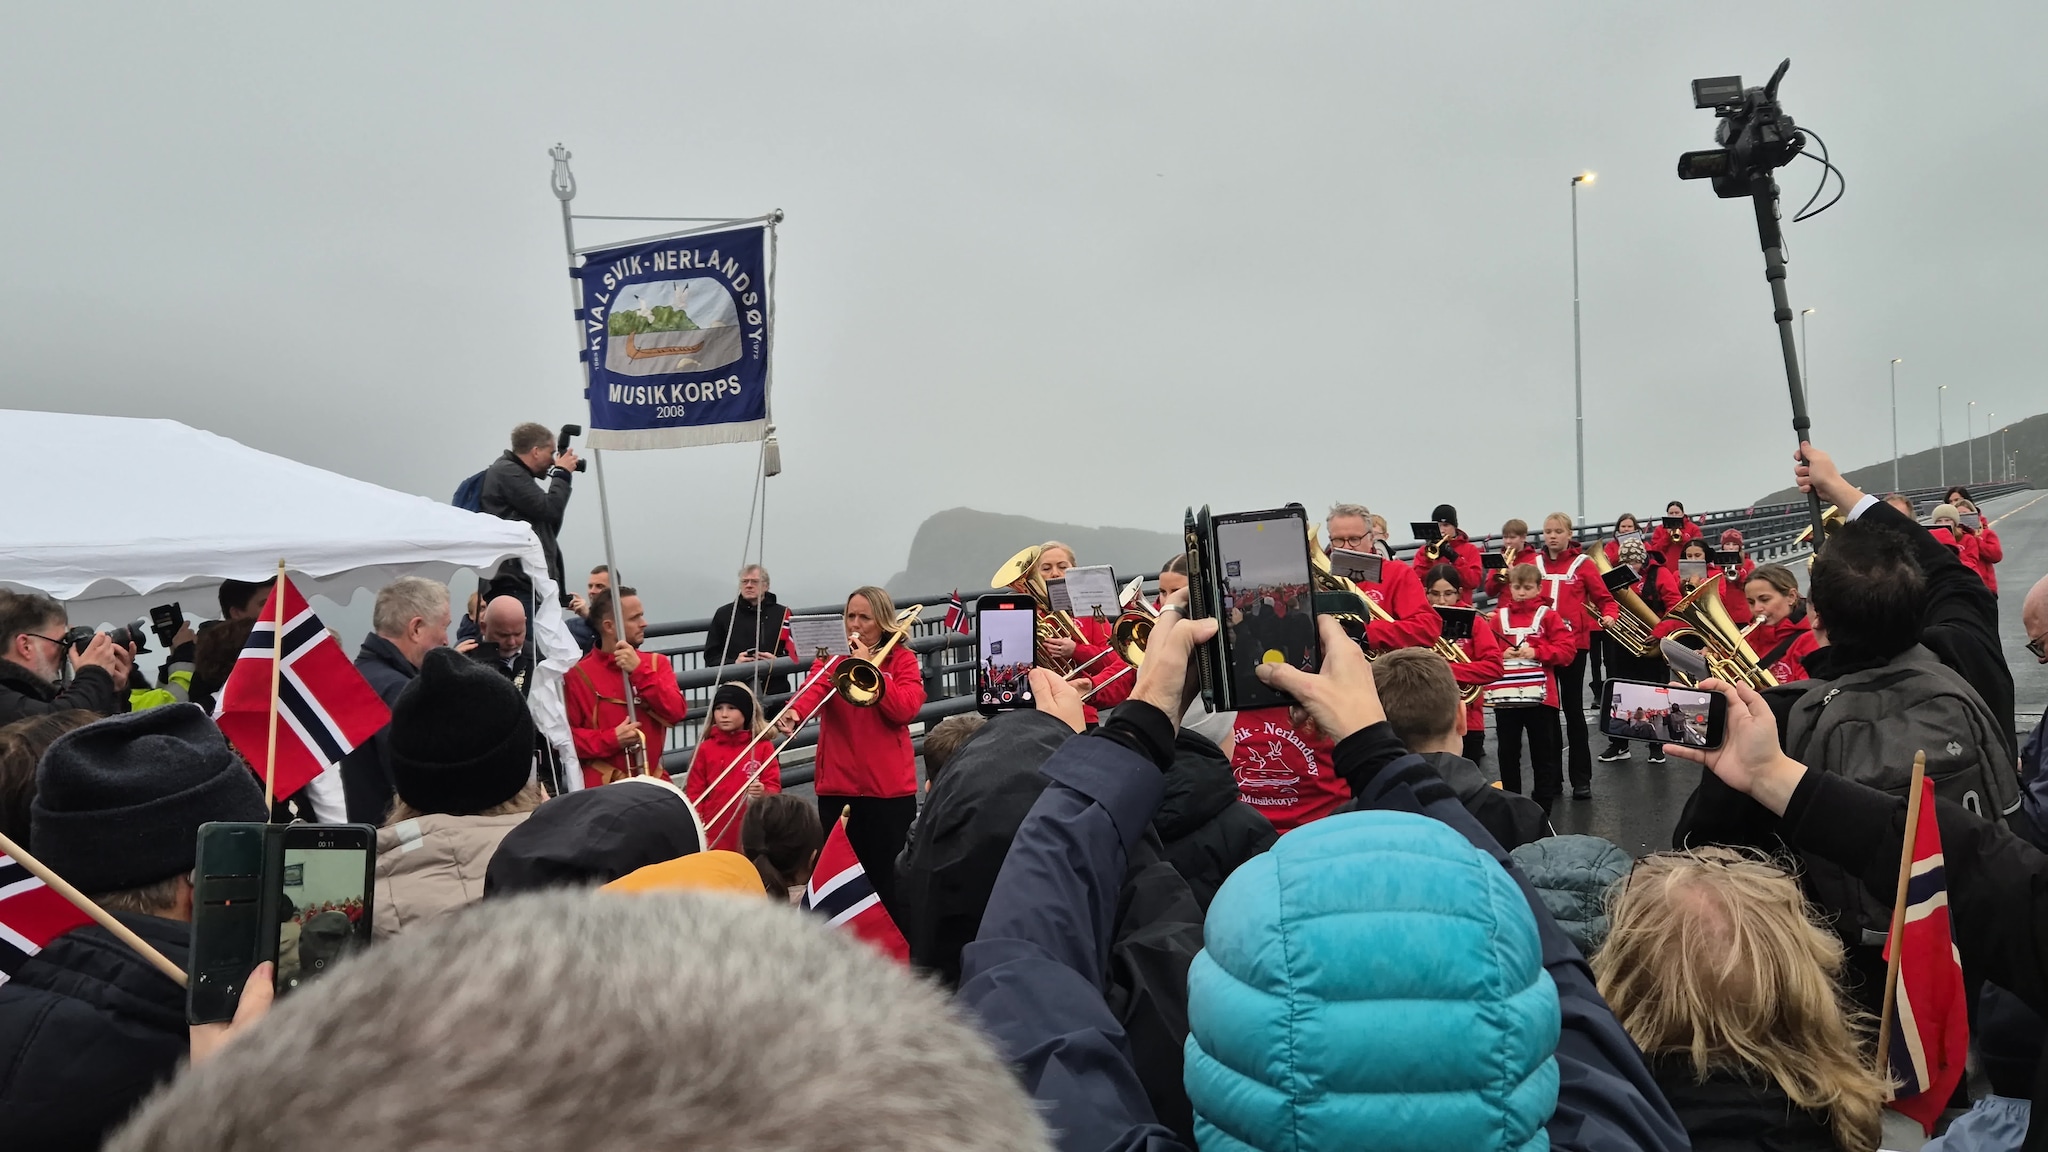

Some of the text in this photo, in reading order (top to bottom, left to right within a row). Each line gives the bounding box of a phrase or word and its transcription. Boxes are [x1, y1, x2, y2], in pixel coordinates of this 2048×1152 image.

[656, 405, 685, 419] 2008
[1234, 727, 1253, 744] vik
[1263, 721, 1319, 776] Nerlandsøy
[1240, 793, 1299, 806] Musikkorps
[317, 840, 335, 848] 00:11
